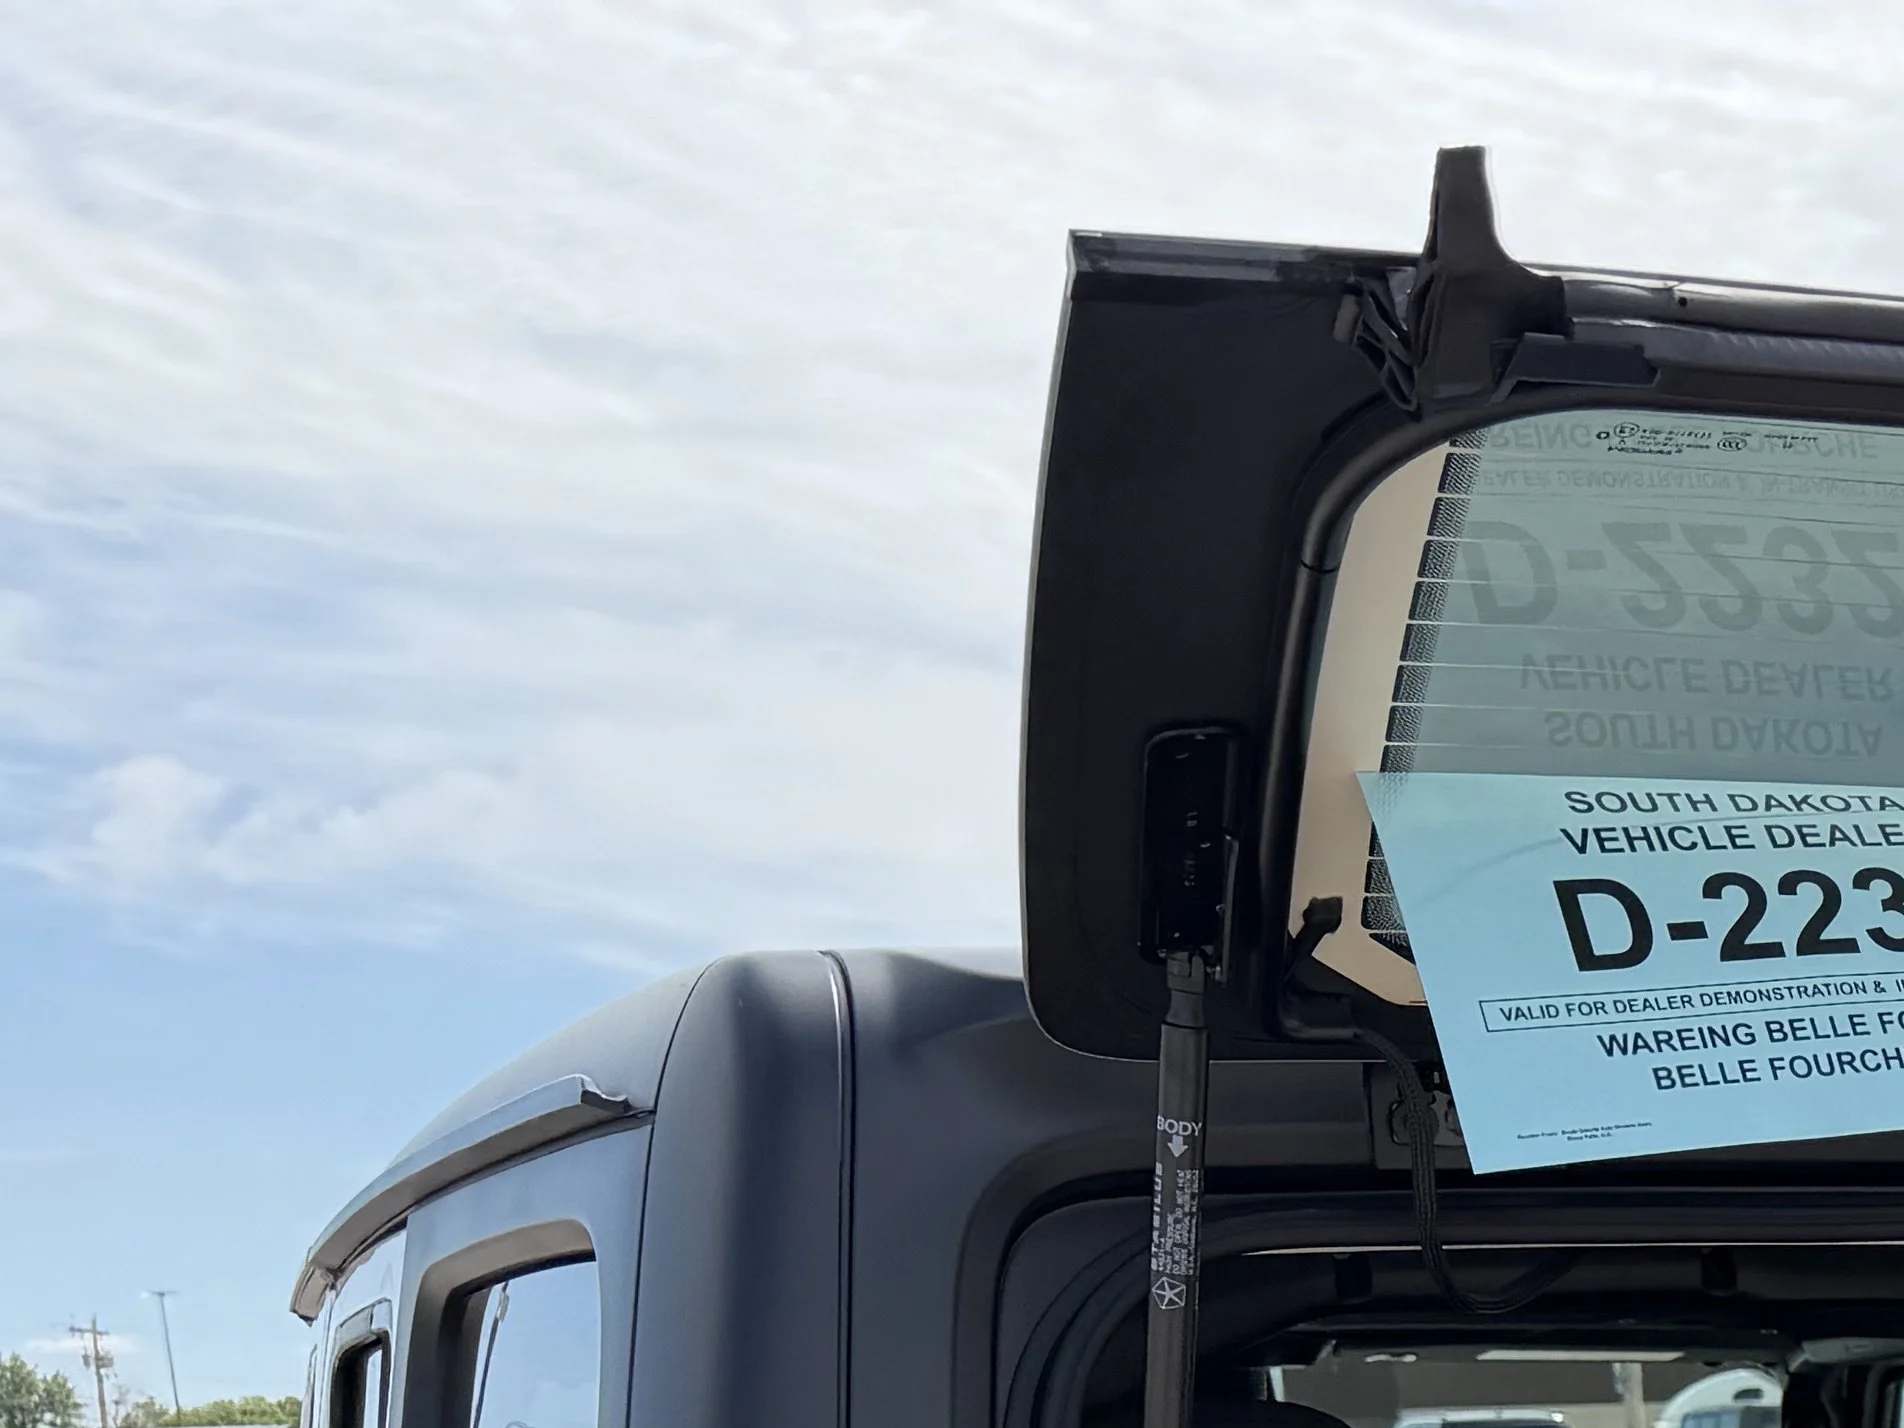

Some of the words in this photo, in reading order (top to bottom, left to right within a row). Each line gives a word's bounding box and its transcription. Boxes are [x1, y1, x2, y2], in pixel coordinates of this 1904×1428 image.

[1563, 790, 1716, 814] SOUTH
[1560, 825, 1757, 855] VEHICLE
[1500, 1004, 1560, 1022] VALID
[1565, 1000, 1608, 1018] FOR
[1614, 994, 1694, 1014] DEALER
[1699, 979, 1868, 1007] DEMONSTRATION
[1873, 980, 1887, 994] &
[1596, 1022, 1757, 1057] WAREING
[1765, 1014, 1871, 1044] BELLE
[1652, 1059, 1761, 1090] BELLE
[1157, 1115, 1202, 1137] BODY
